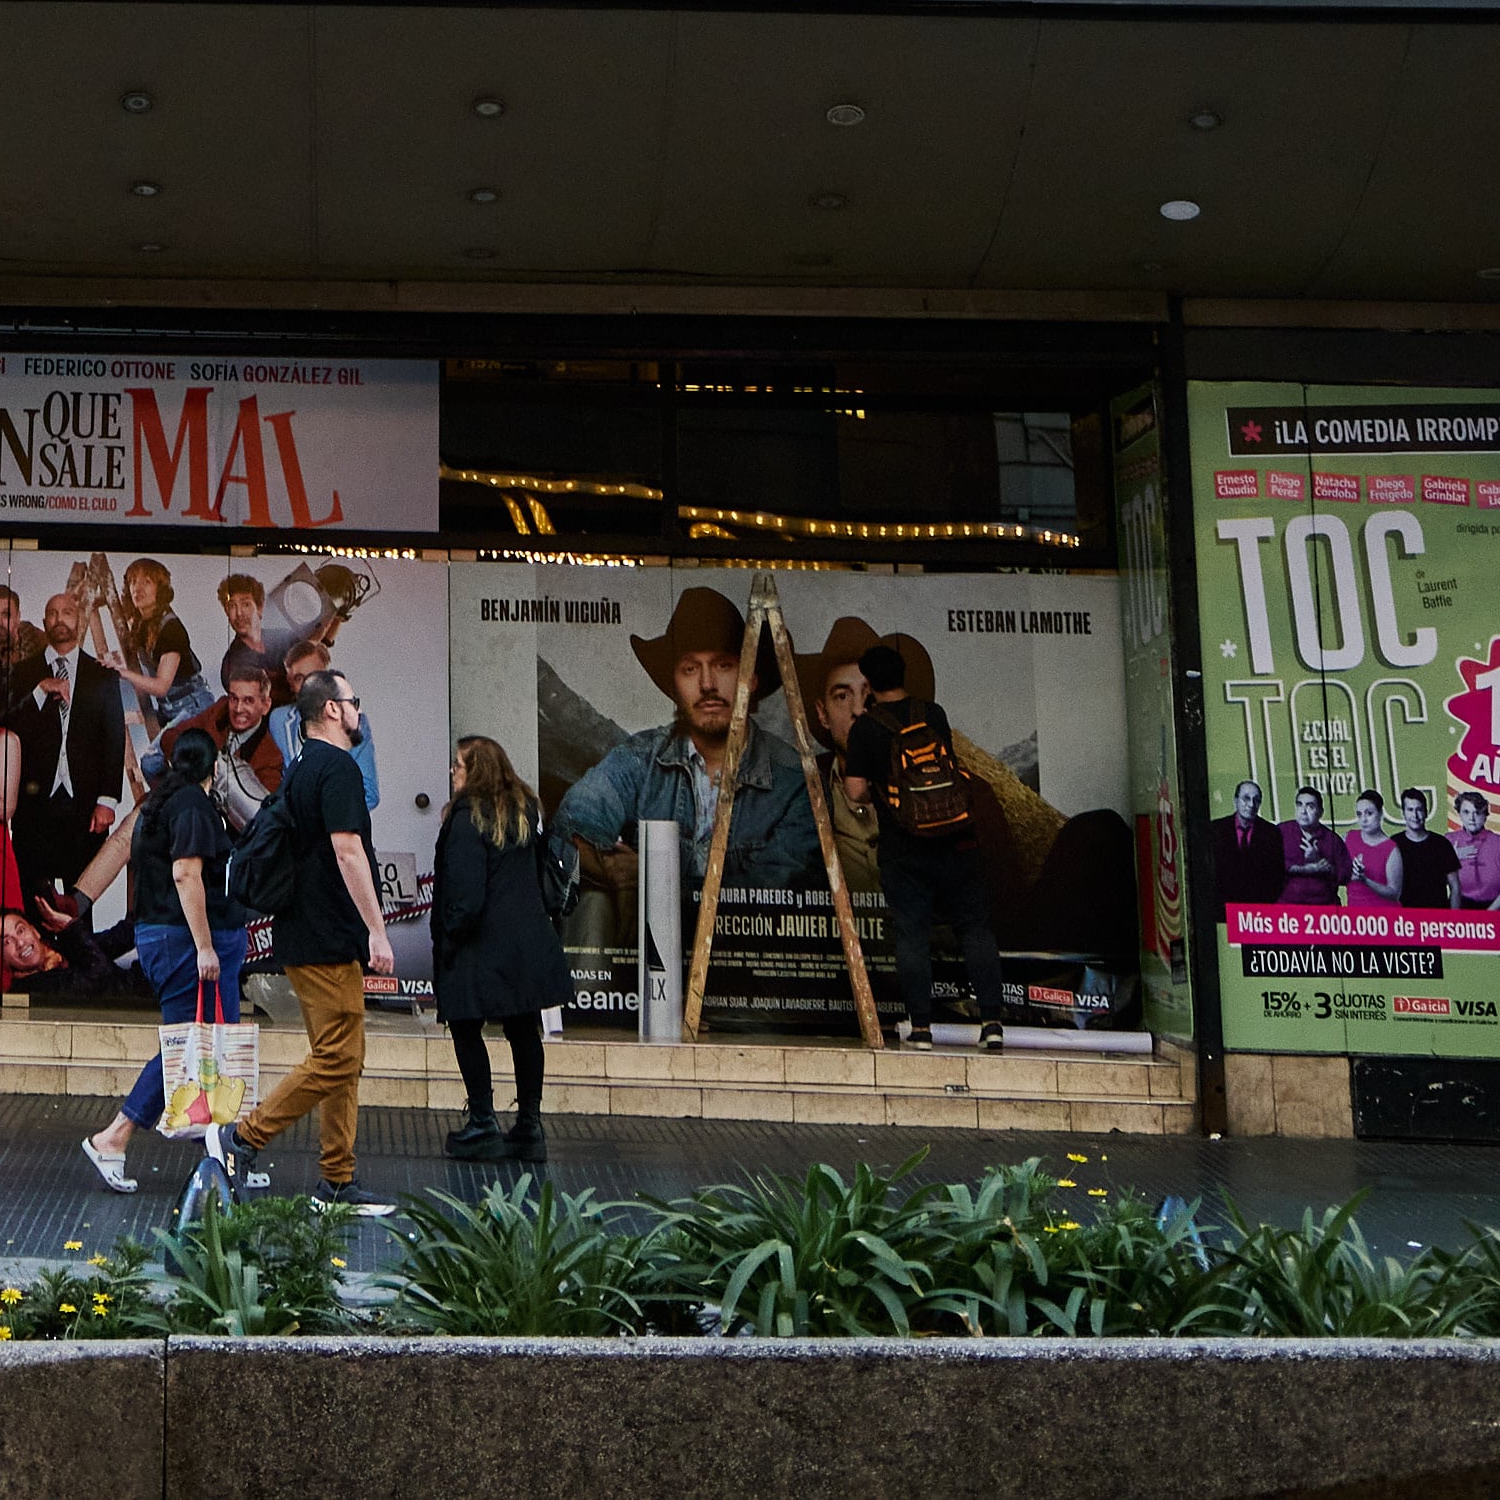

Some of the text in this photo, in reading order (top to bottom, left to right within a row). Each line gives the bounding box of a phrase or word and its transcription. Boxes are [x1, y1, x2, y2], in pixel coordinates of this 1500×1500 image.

[24, 357, 107, 378] FEDERICO
[111, 360, 176, 380] OTTONE
[190, 359, 239, 382] SOFÍA
[243, 361, 333, 386] GONZÁLEZ
[337, 366, 364, 386] GIL
[43, 390, 122, 442] QUE
[1315, 419, 1410, 443] COMEDIA
[38, 443, 126, 491] SALE
[124, 387, 344, 529] MAL
[1217, 510, 1438, 674] TOC
[480, 595, 622, 625] BENJAMÍN VICUÑA
[948, 610, 1091, 634] ESTEBAN LAMOTHE
[1238, 911, 1495, 941] Más de 2.000.000 de personas
[1251, 945, 1434, 974] ¿TODAVÍA NO LA VISTE?
[1454, 1000, 1497, 1016] VISA
